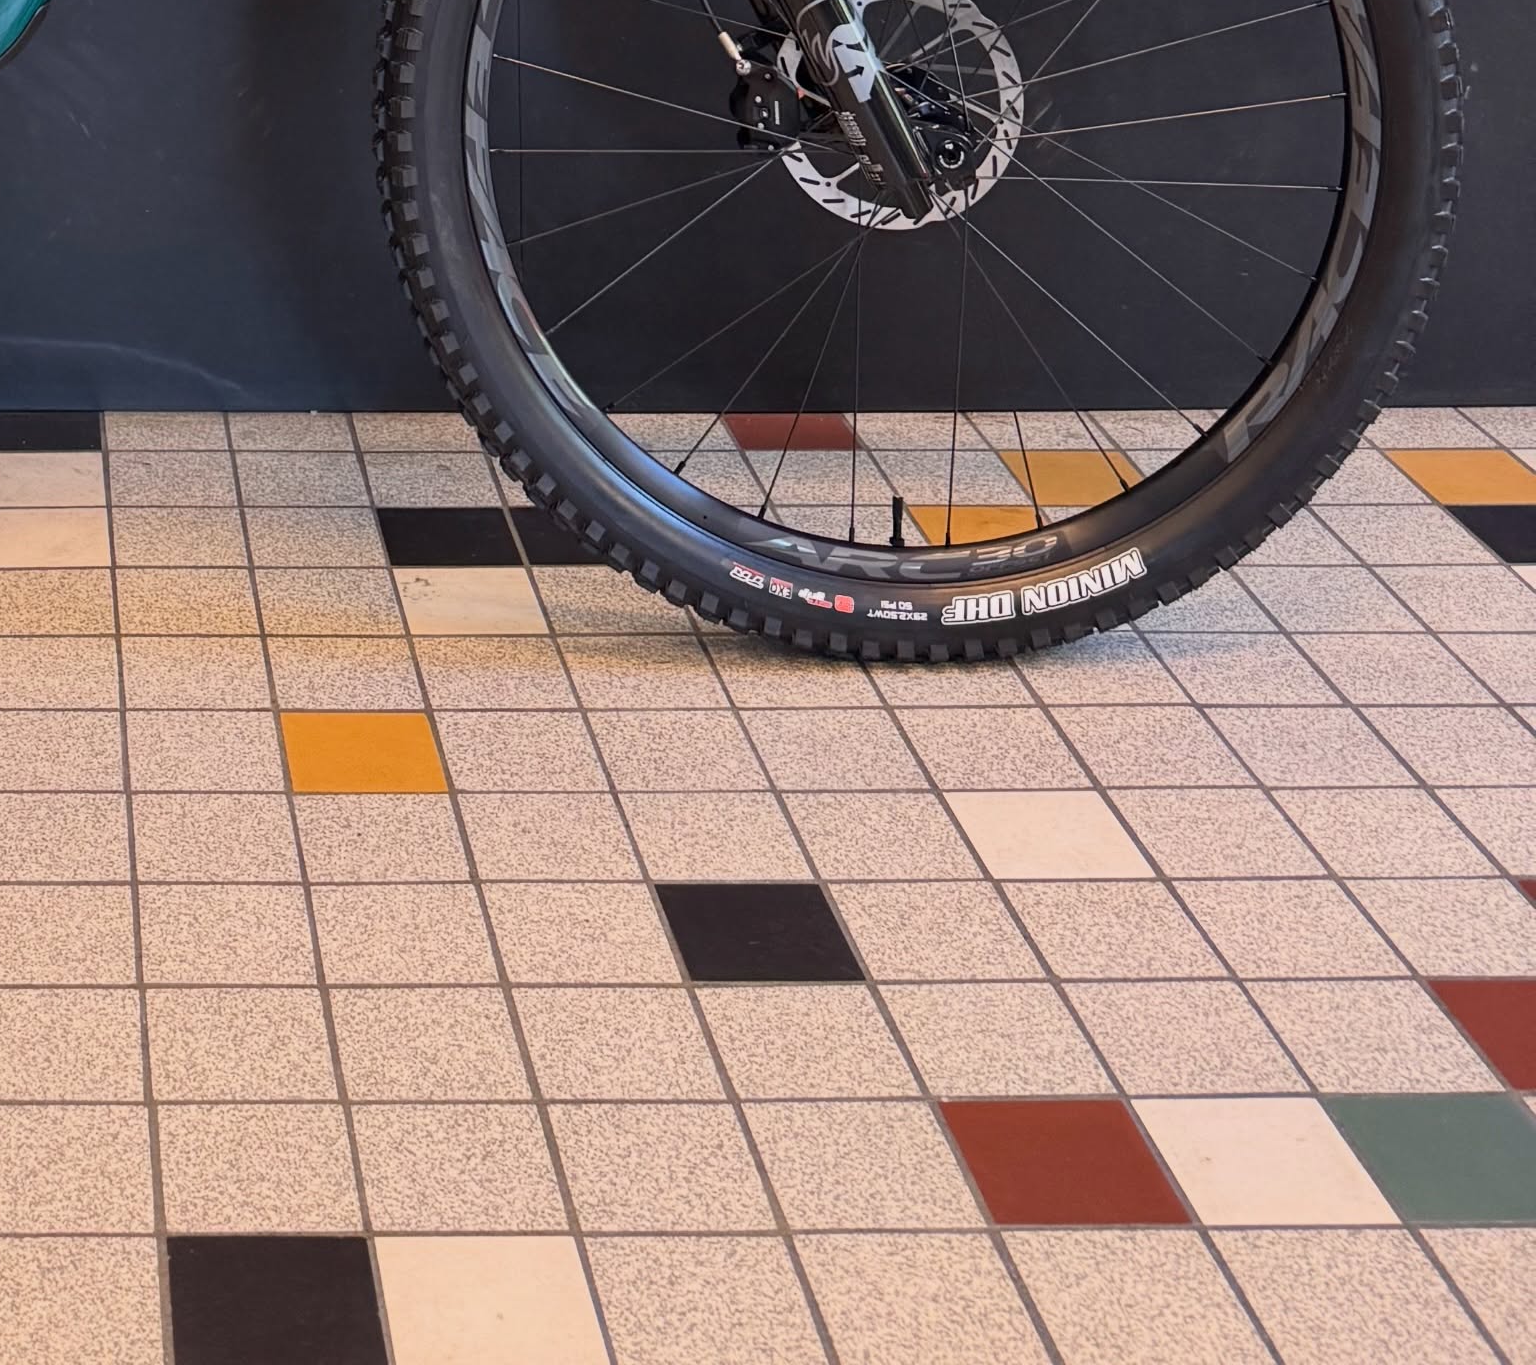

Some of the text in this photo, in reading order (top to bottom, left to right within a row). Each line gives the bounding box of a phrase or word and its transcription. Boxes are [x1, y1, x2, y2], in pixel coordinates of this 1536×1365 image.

[769, 582, 793, 599] EXO
[941, 547, 1148, 626] MINION DHF
[880, 600, 913, 610] 50 PSI
